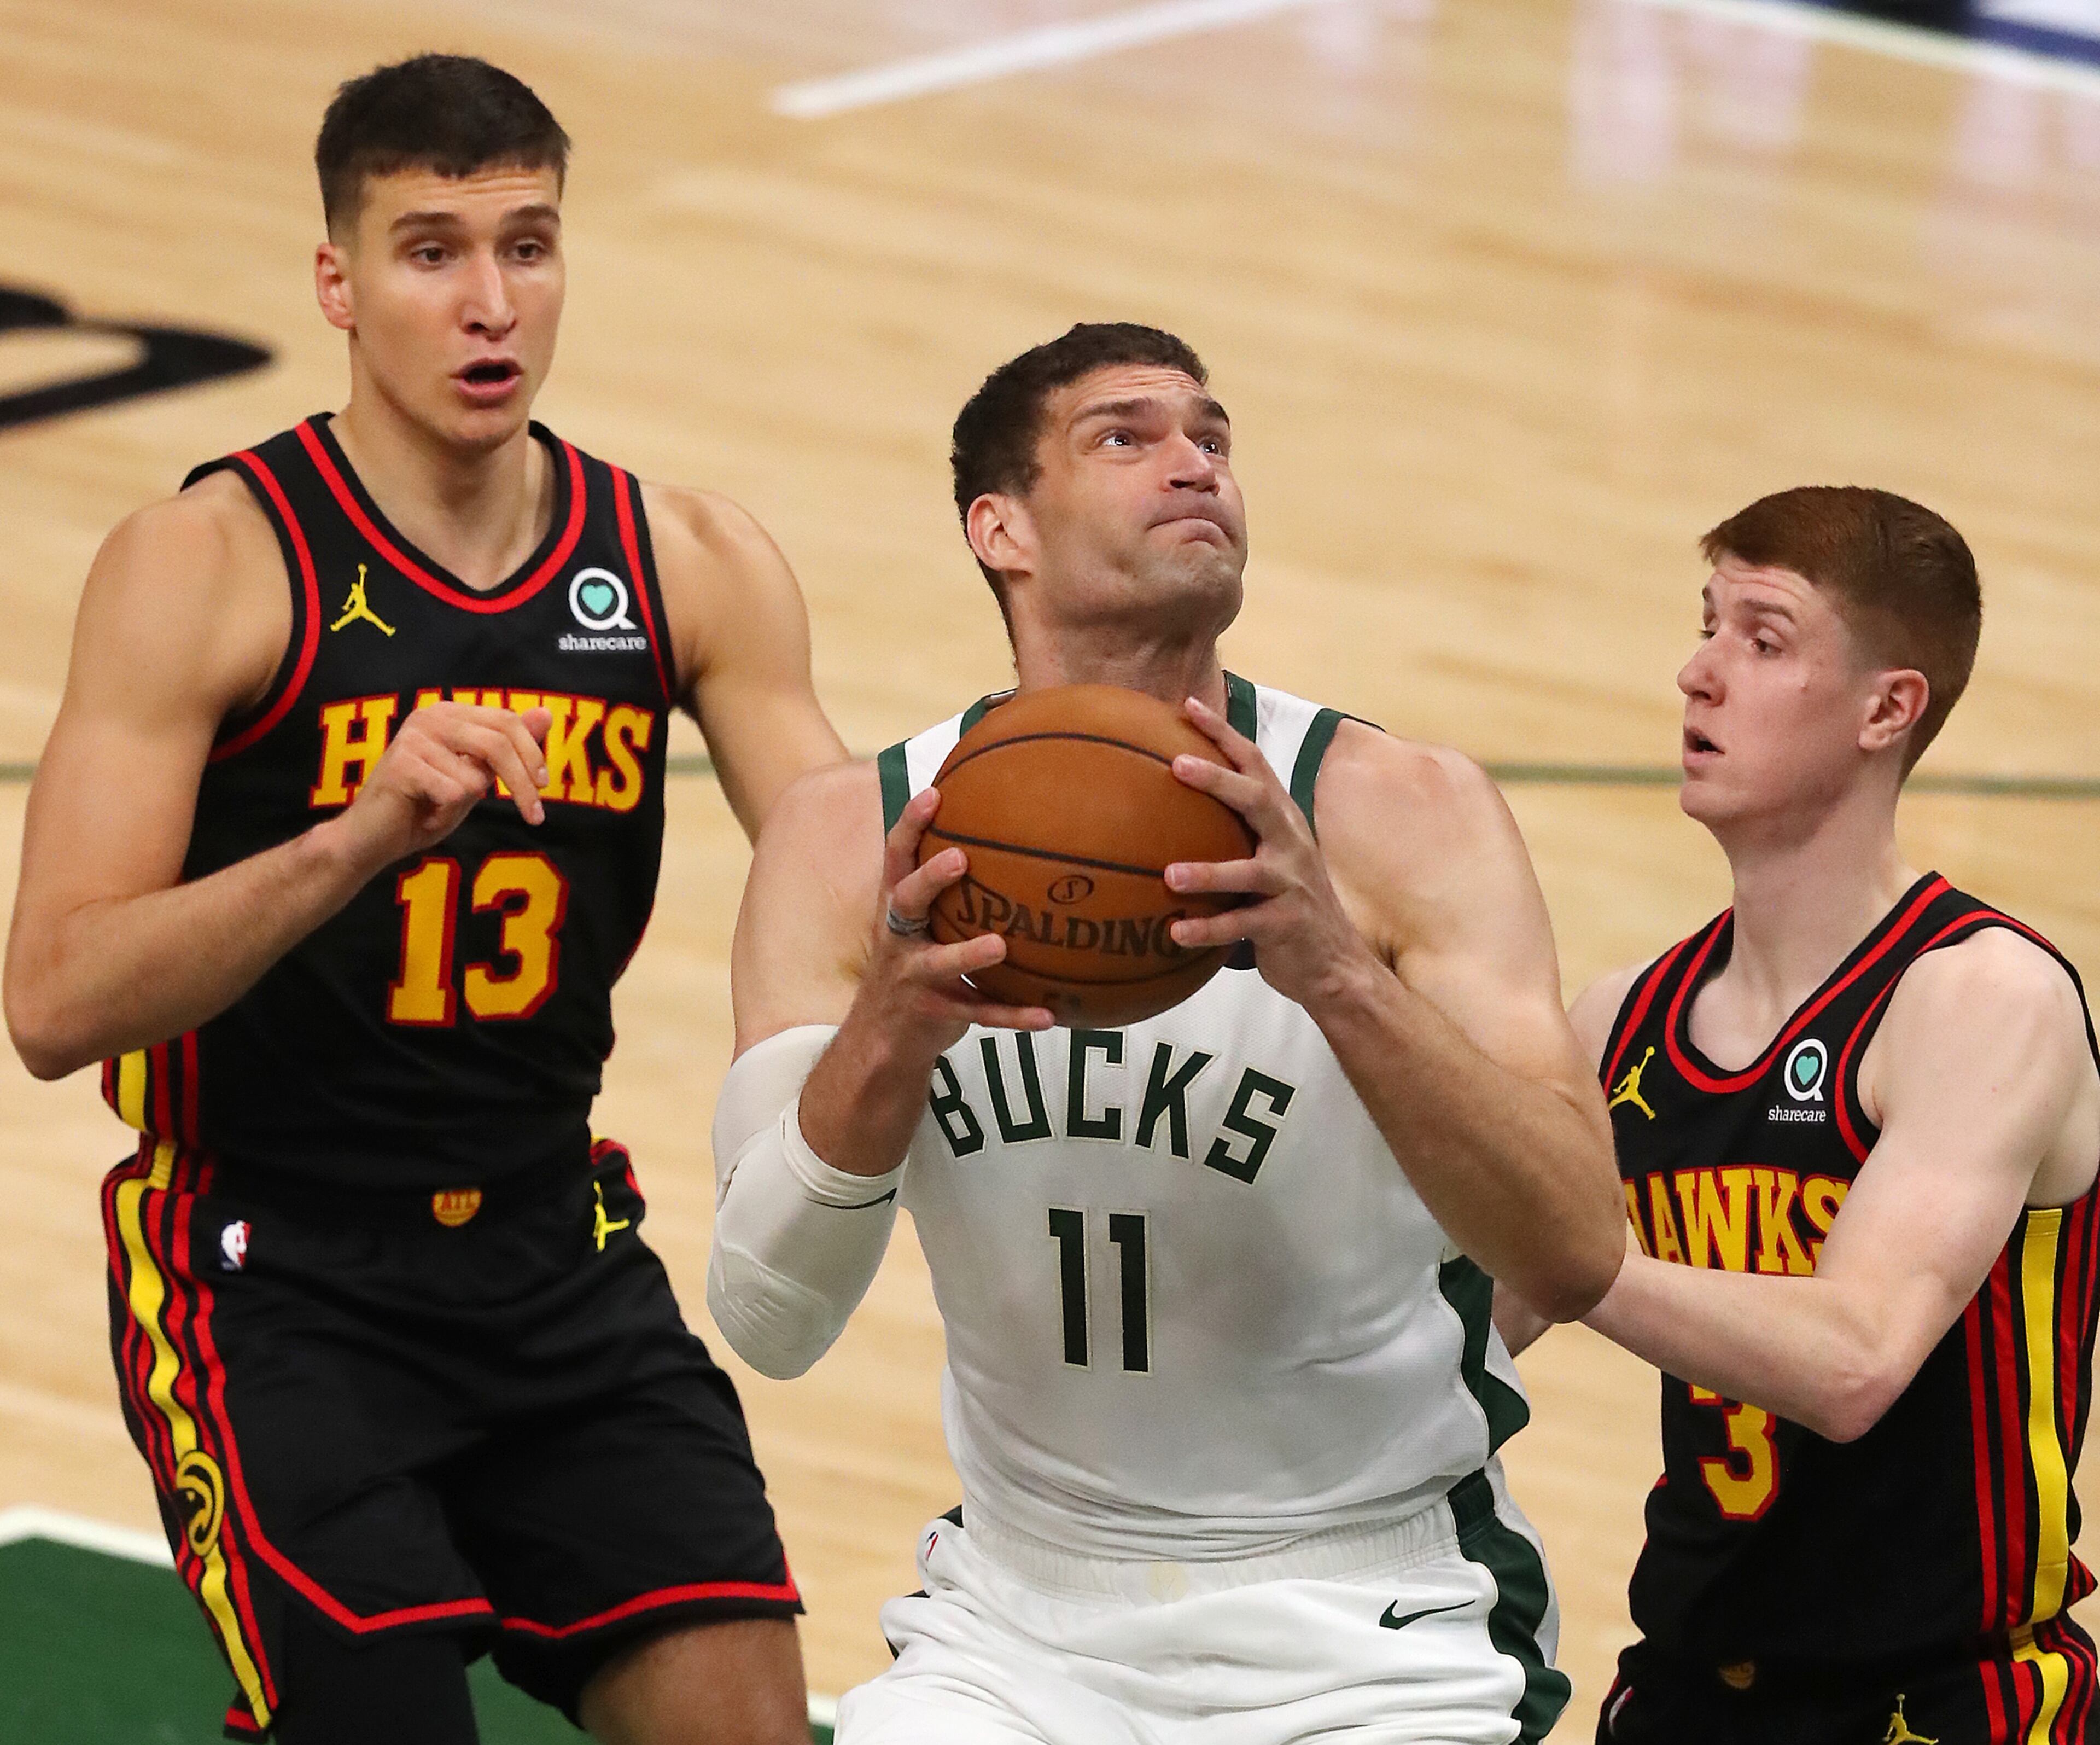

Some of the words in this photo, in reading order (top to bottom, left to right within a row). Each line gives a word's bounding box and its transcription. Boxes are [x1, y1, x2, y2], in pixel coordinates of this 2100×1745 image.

[558, 633, 648, 651] sharecare
[308, 687, 655, 814] HKS
[386, 851, 569, 1028] 13
[930, 1028, 1297, 1186] BUCKS
[1768, 1104, 1827, 1122] sharecare
[1047, 1206, 1151, 1374] 11
[1688, 1382, 1781, 1522] 3
